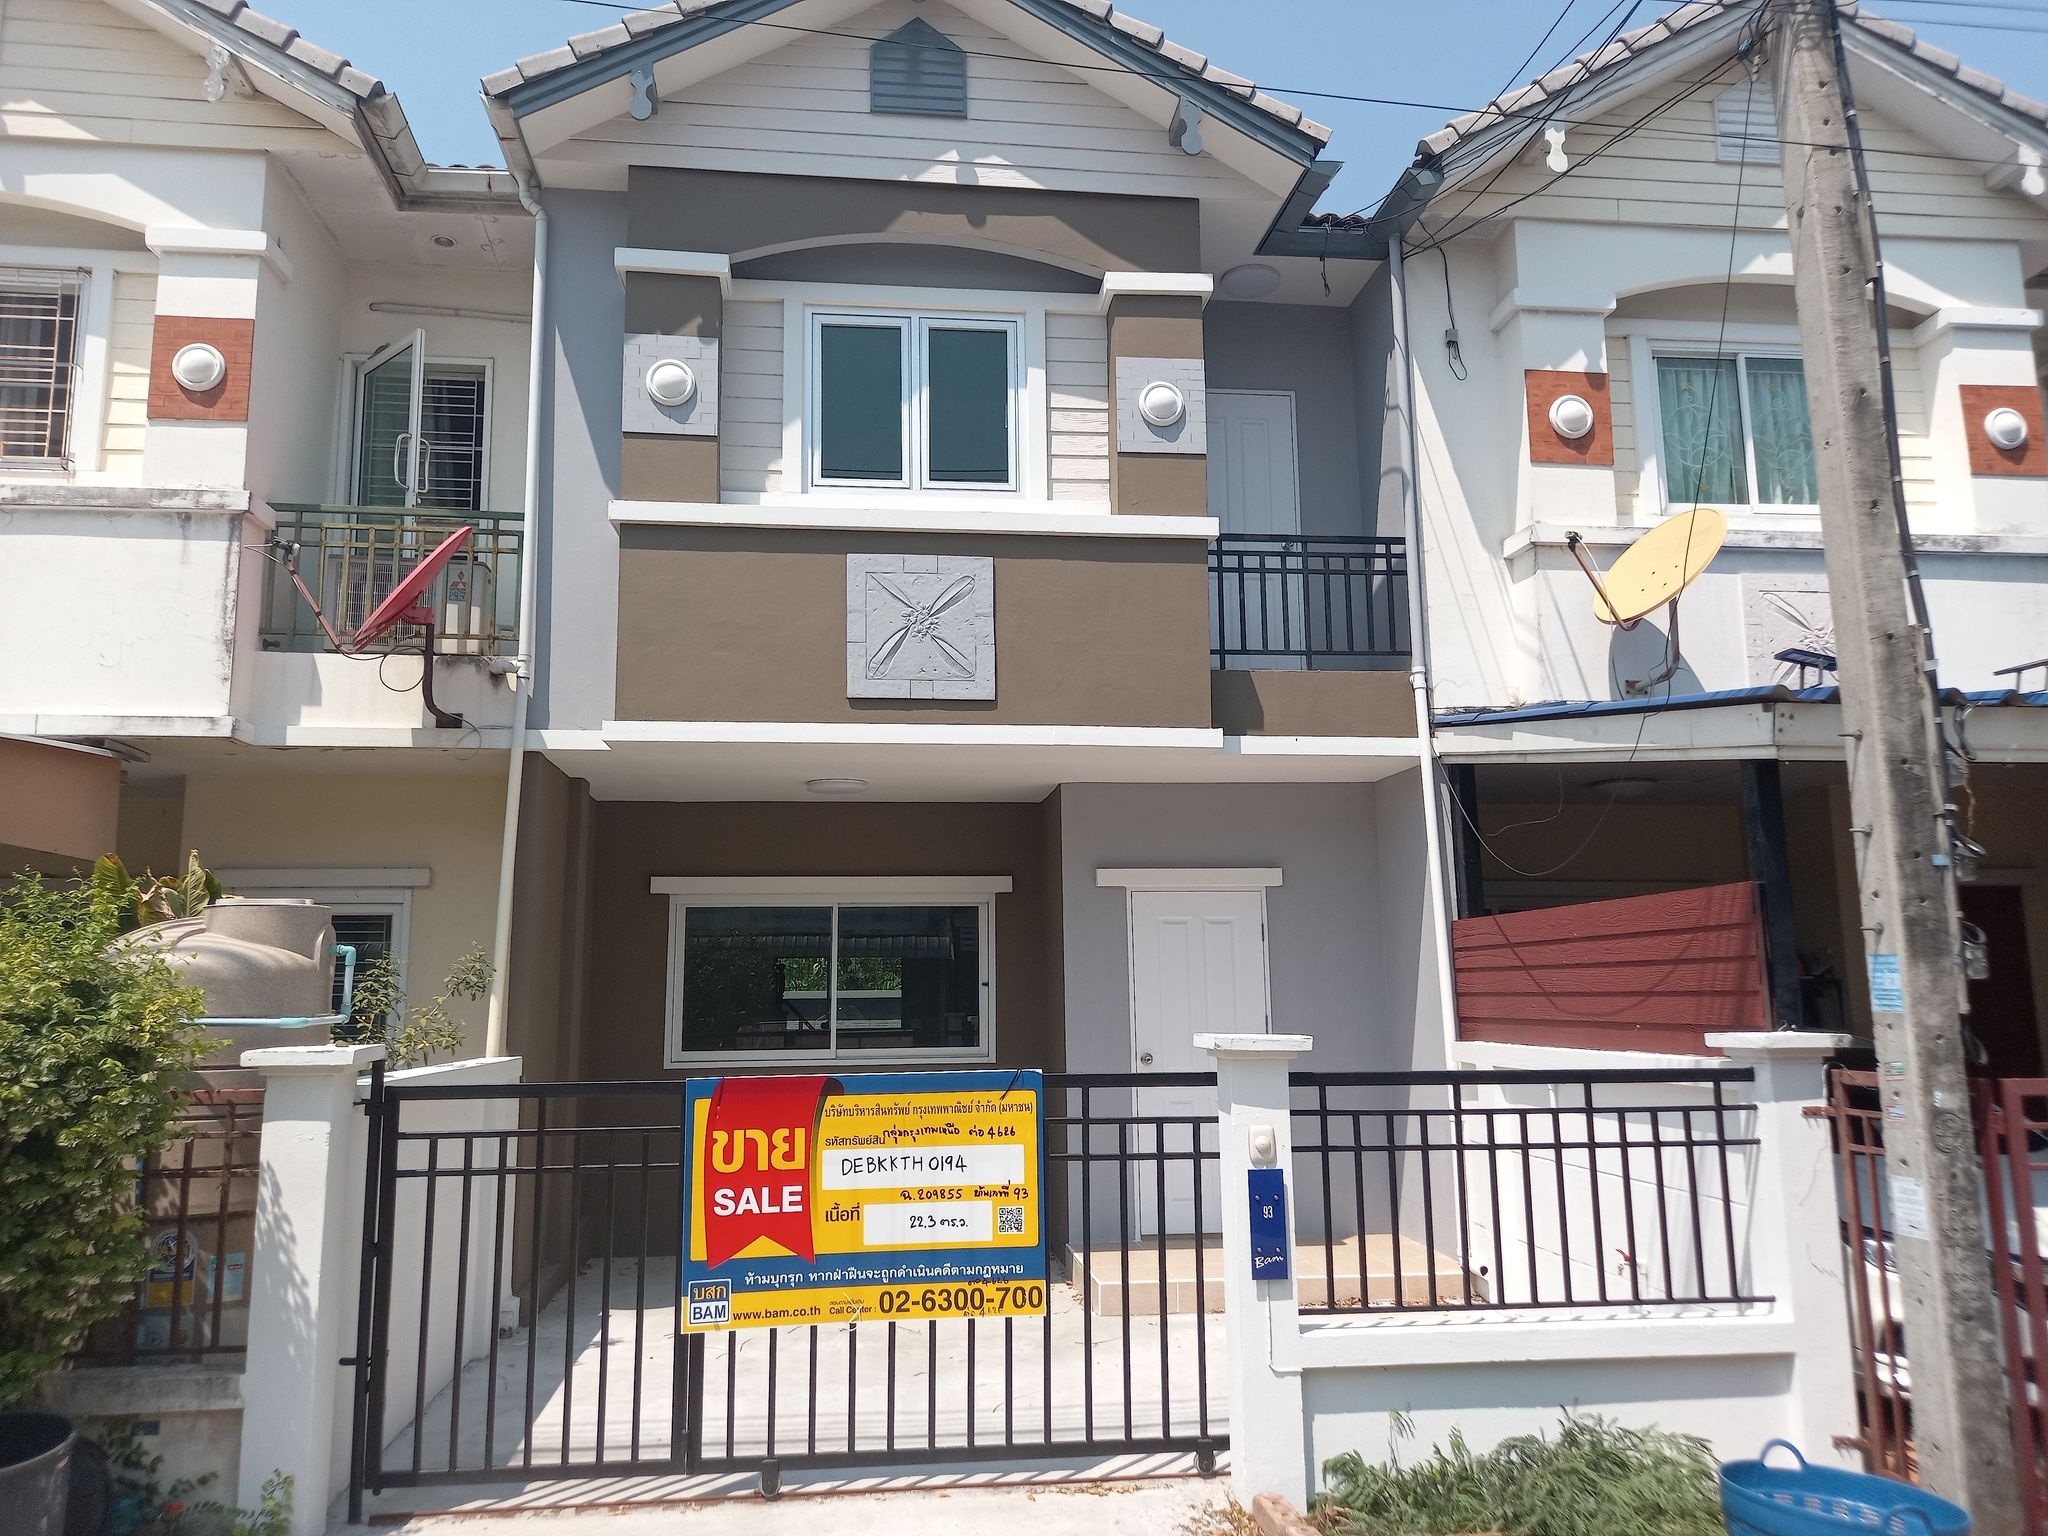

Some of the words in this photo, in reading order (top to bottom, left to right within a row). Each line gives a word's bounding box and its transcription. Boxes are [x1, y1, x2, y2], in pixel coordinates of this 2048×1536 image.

[824, 1101, 911, 1117] บริษัทบริหารสินทรัพย์
[912, 1099, 973, 1119] กรุงเทพพาณิชย์
[975, 1099, 996, 1114] จำกัด
[999, 1099, 1033, 1115] (มหาชน)
[825, 1133, 886, 1146] รหัสทรัพย์สิน
[988, 1125, 1015, 1139] 4626
[712, 1128, 805, 1173] ขาย
[928, 1154, 967, 1172] 0194
[713, 1185, 803, 1216] SALE
[1014, 1187, 1029, 1200] 93
[825, 1202, 860, 1222] เนื้อที่
[1263, 1205, 1273, 1218] 93
[909, 1215, 937, 1229] 22.3
[1254, 1255, 1284, 1269] Bam
[744, 1272, 803, 1288] ห้ามบุกรุก
[693, 1284, 726, 1301] บสก
[879, 1285, 1043, 1315] 02-6300-700
[693, 1305, 726, 1320] BAM
[733, 1305, 821, 1321] www.bam.co.th
[829, 1306, 844, 1314] Call
